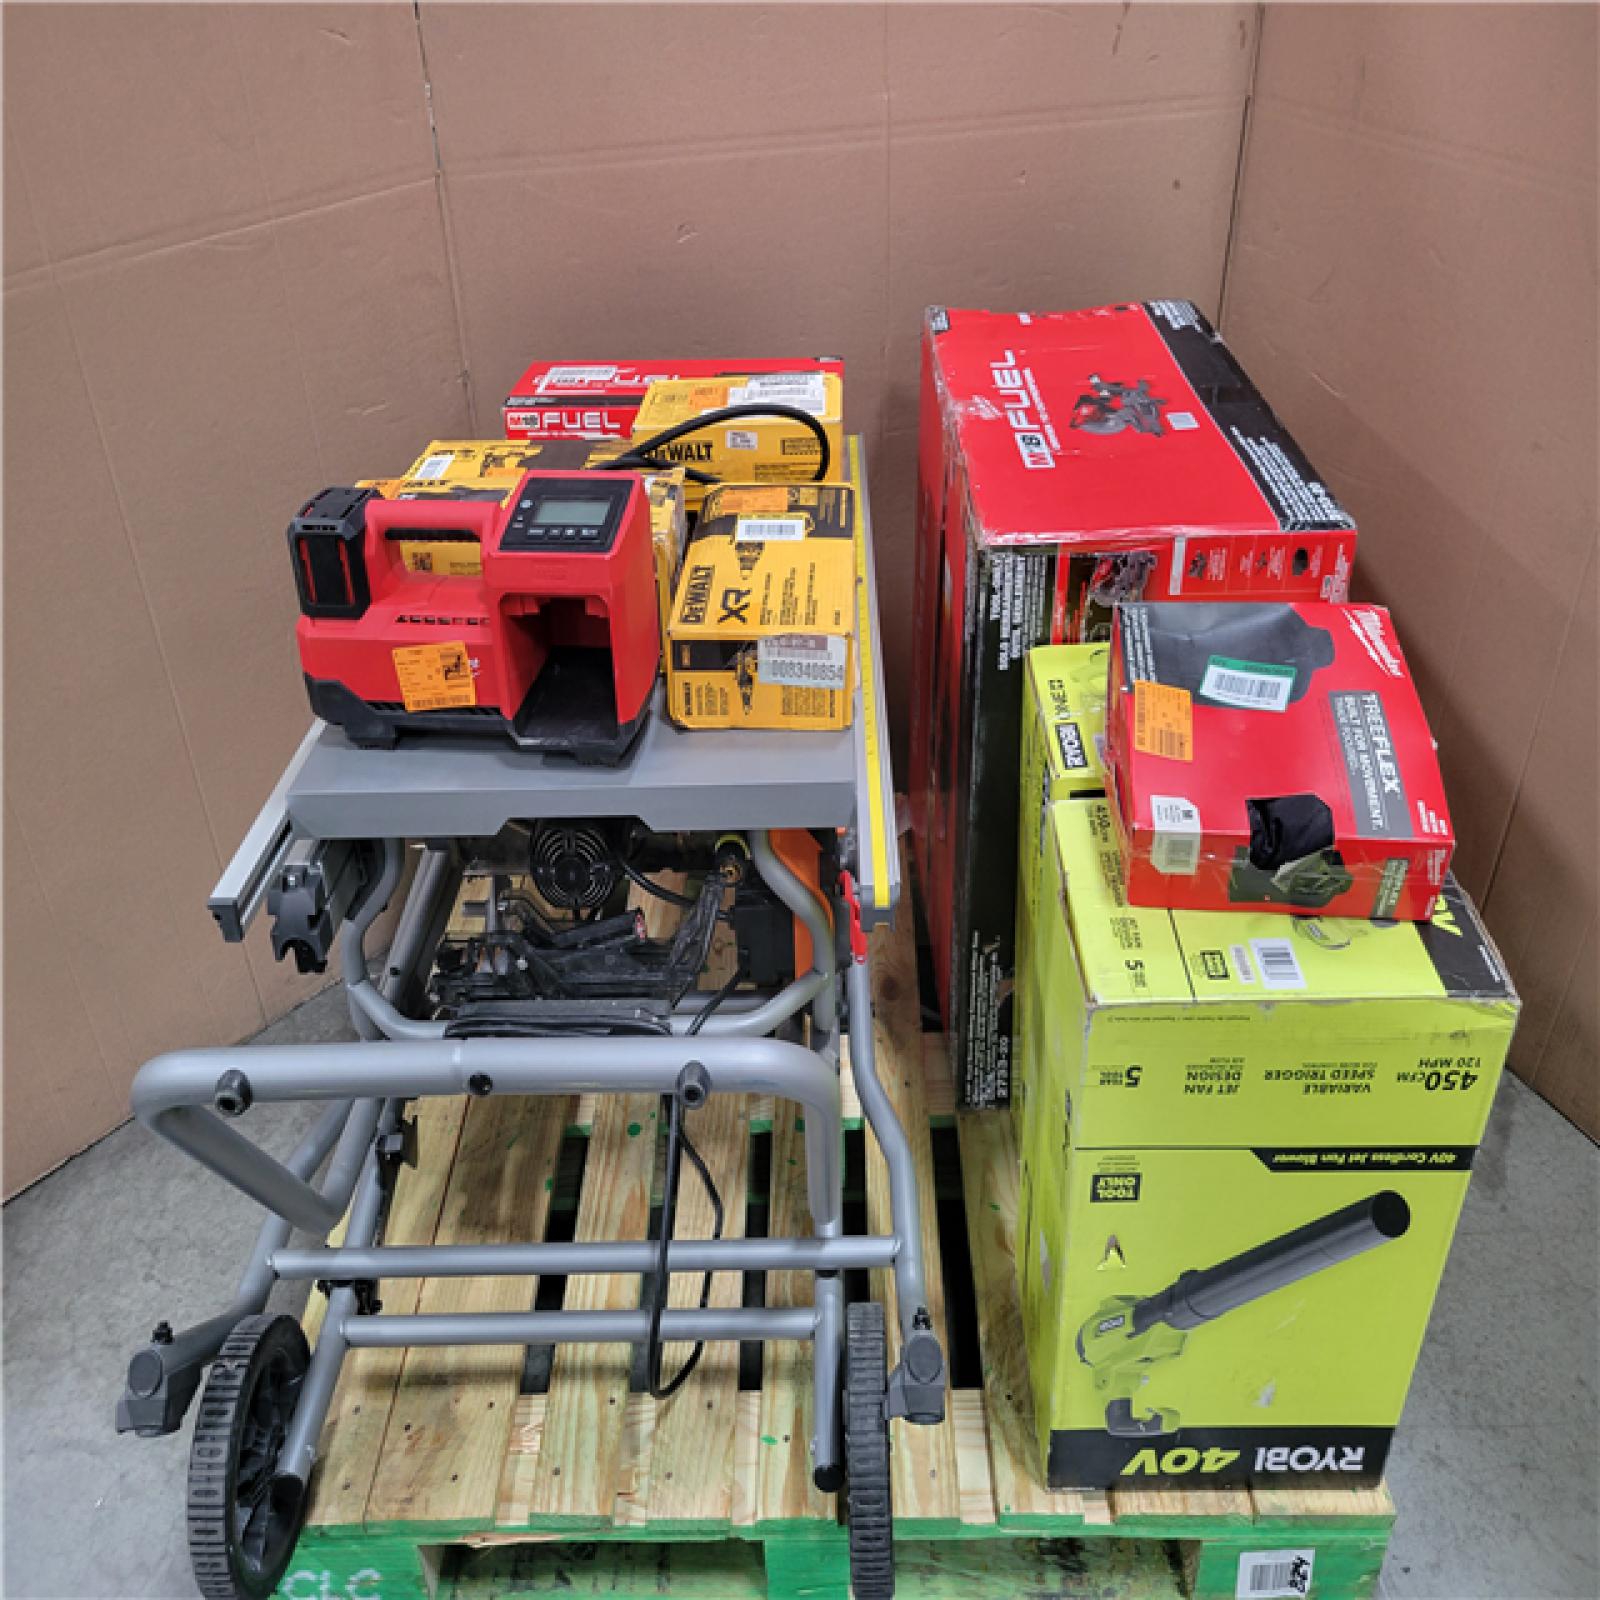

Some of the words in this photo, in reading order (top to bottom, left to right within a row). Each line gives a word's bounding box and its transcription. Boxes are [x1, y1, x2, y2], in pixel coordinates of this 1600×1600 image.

[990, 350, 1040, 431] FUEL
[543, 411, 620, 430] FUEL
[716, 588, 751, 624] XR
[1418, 1057, 1453, 1069] MPH
[1125, 1065, 1143, 1088] 5
[1185, 1071, 1242, 1082] DESIGN
[1264, 1069, 1327, 1081] TRIGGER
[1330, 1069, 1376, 1081] SPEED
[1184, 1084, 1214, 1096] FAN
[1217, 1084, 1242, 1096] JET
[1303, 1083, 1372, 1096] VARIABLE
[1320, 1153, 1346, 1164] Fan
[1349, 1152, 1368, 1164] Jet
[1371, 1152, 1427, 1165] Cordless
[1096, 1177, 1136, 1188] ONLY
[1096, 1189, 1136, 1199] TOOL
[1120, 1448, 1241, 1475] 40V
[1254, 1446, 1364, 1472] RYOBI
